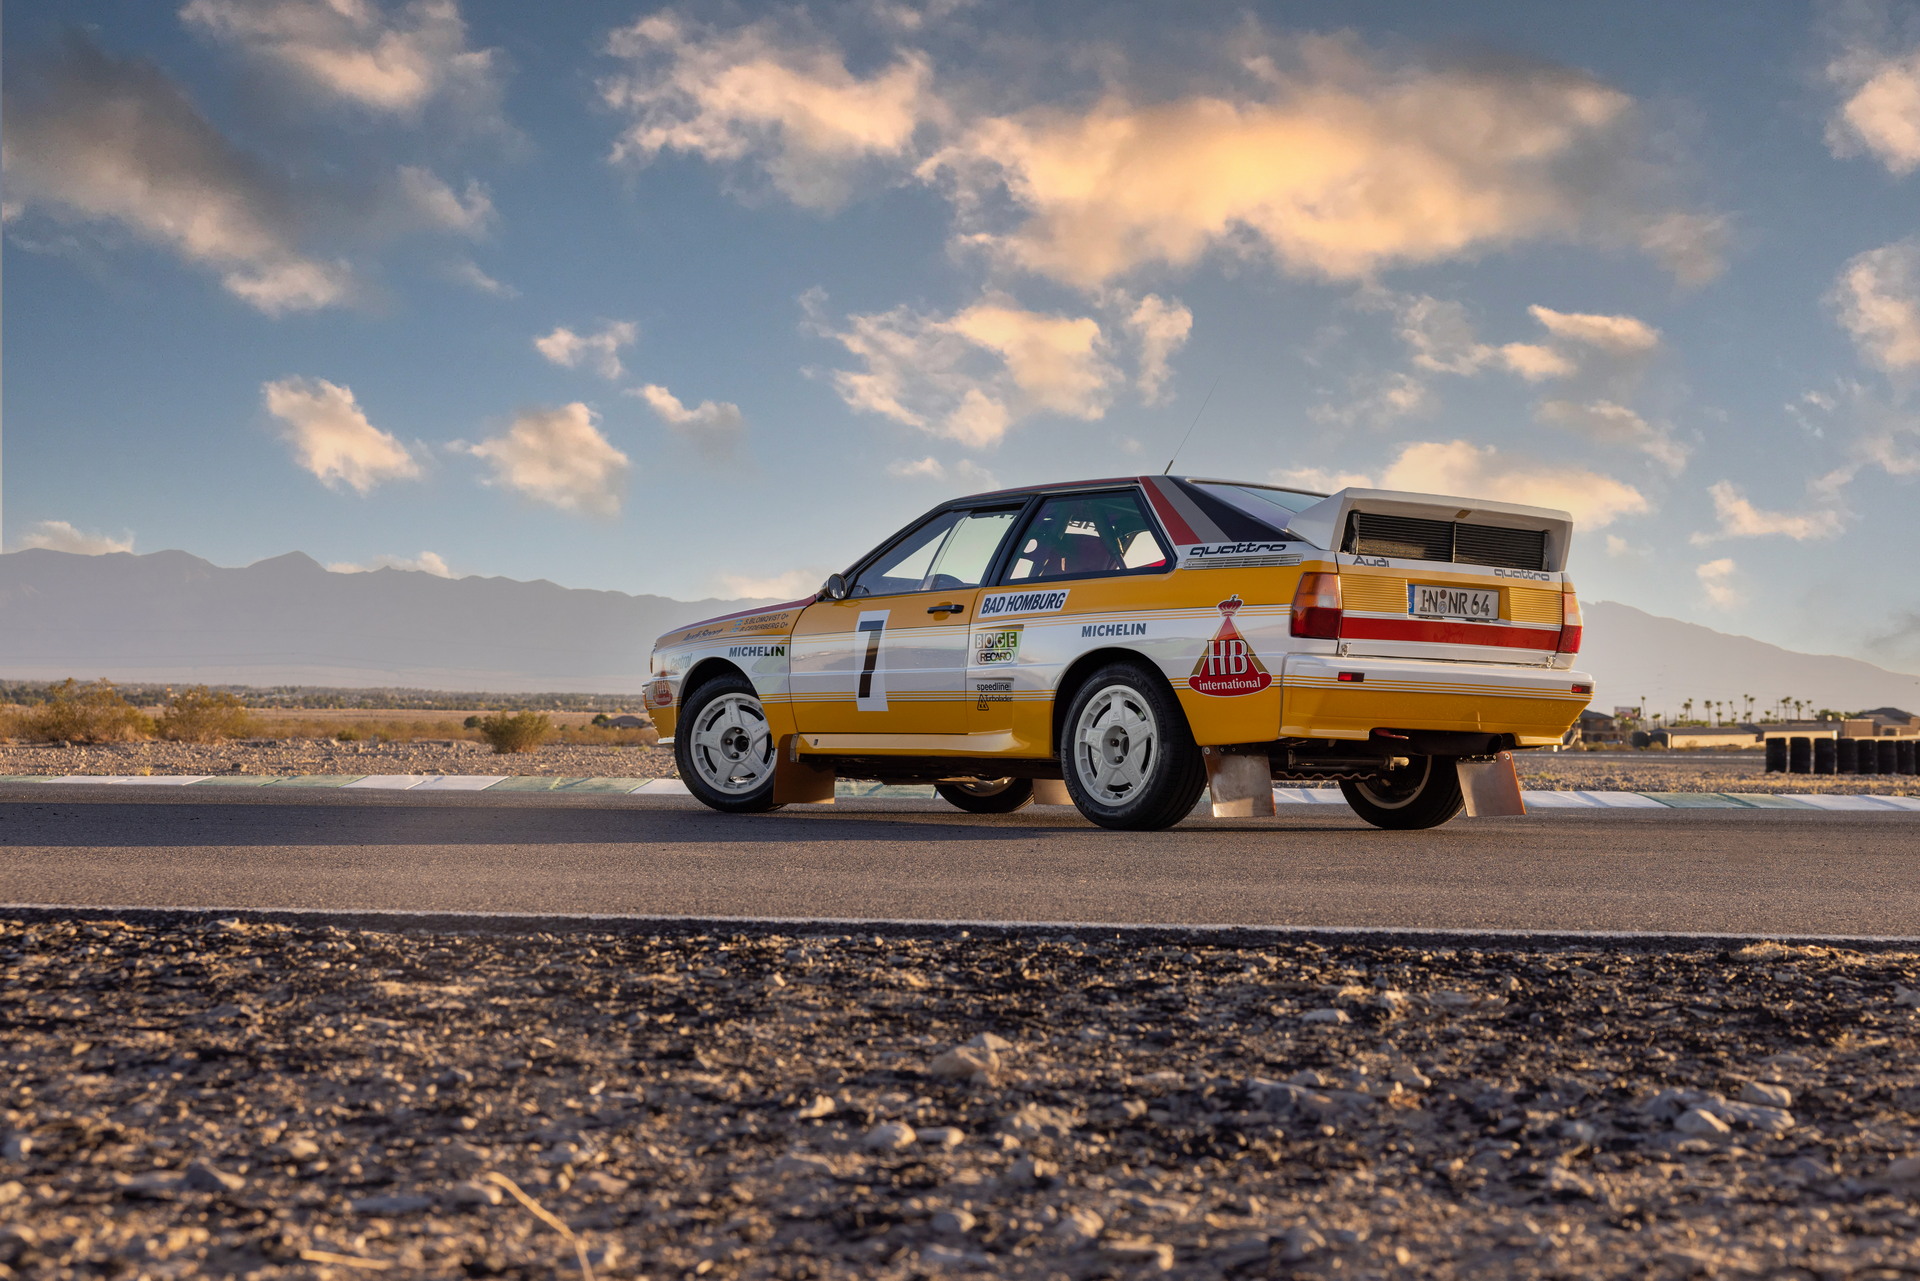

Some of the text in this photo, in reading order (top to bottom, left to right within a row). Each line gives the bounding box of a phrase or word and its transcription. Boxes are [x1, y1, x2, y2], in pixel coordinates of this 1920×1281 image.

[1190, 542, 1286, 557] quattro
[1353, 555, 1390, 568] Audi
[1493, 568, 1550, 581] quattro
[981, 592, 1066, 614] BAD HOMBURG
[1419, 589, 1490, 616] IN NR 64
[1081, 623, 1147, 637] MICHELIN
[975, 632, 1017, 648] BOGE
[729, 646, 785, 657] MICHELIN
[980, 651, 1011, 662] RECARO
[1207, 639, 1248, 676] HB
[858, 620, 885, 698] 7
[977, 682, 1009, 692] speedline
[1199, 677, 1261, 691] international
